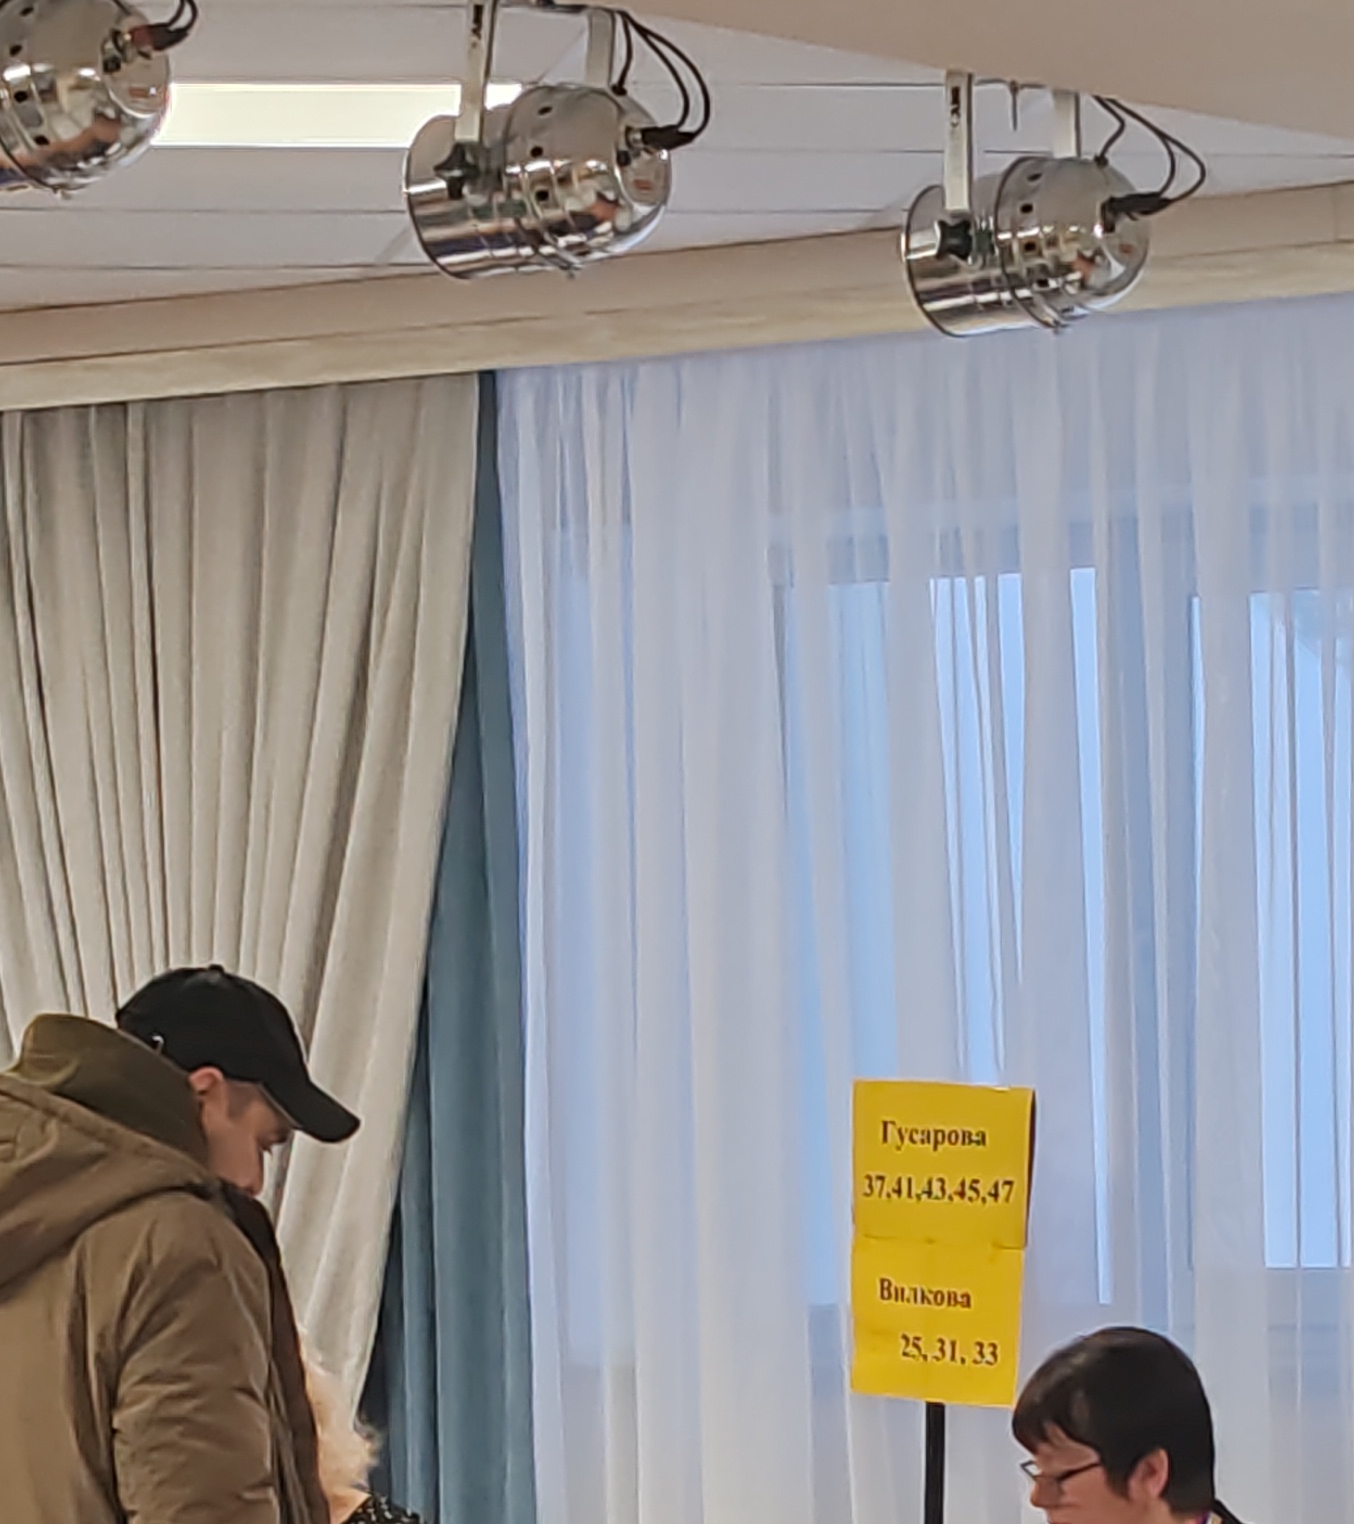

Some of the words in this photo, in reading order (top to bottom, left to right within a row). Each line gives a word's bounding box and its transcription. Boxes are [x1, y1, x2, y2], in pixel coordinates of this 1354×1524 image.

[880, 1120, 987, 1151] Гусарова
[878, 1278, 972, 1309] Вилкова
[900, 1333, 927, 1362] 25,
[933, 1338, 966, 1365] 31,
[972, 1341, 998, 1366] 33
